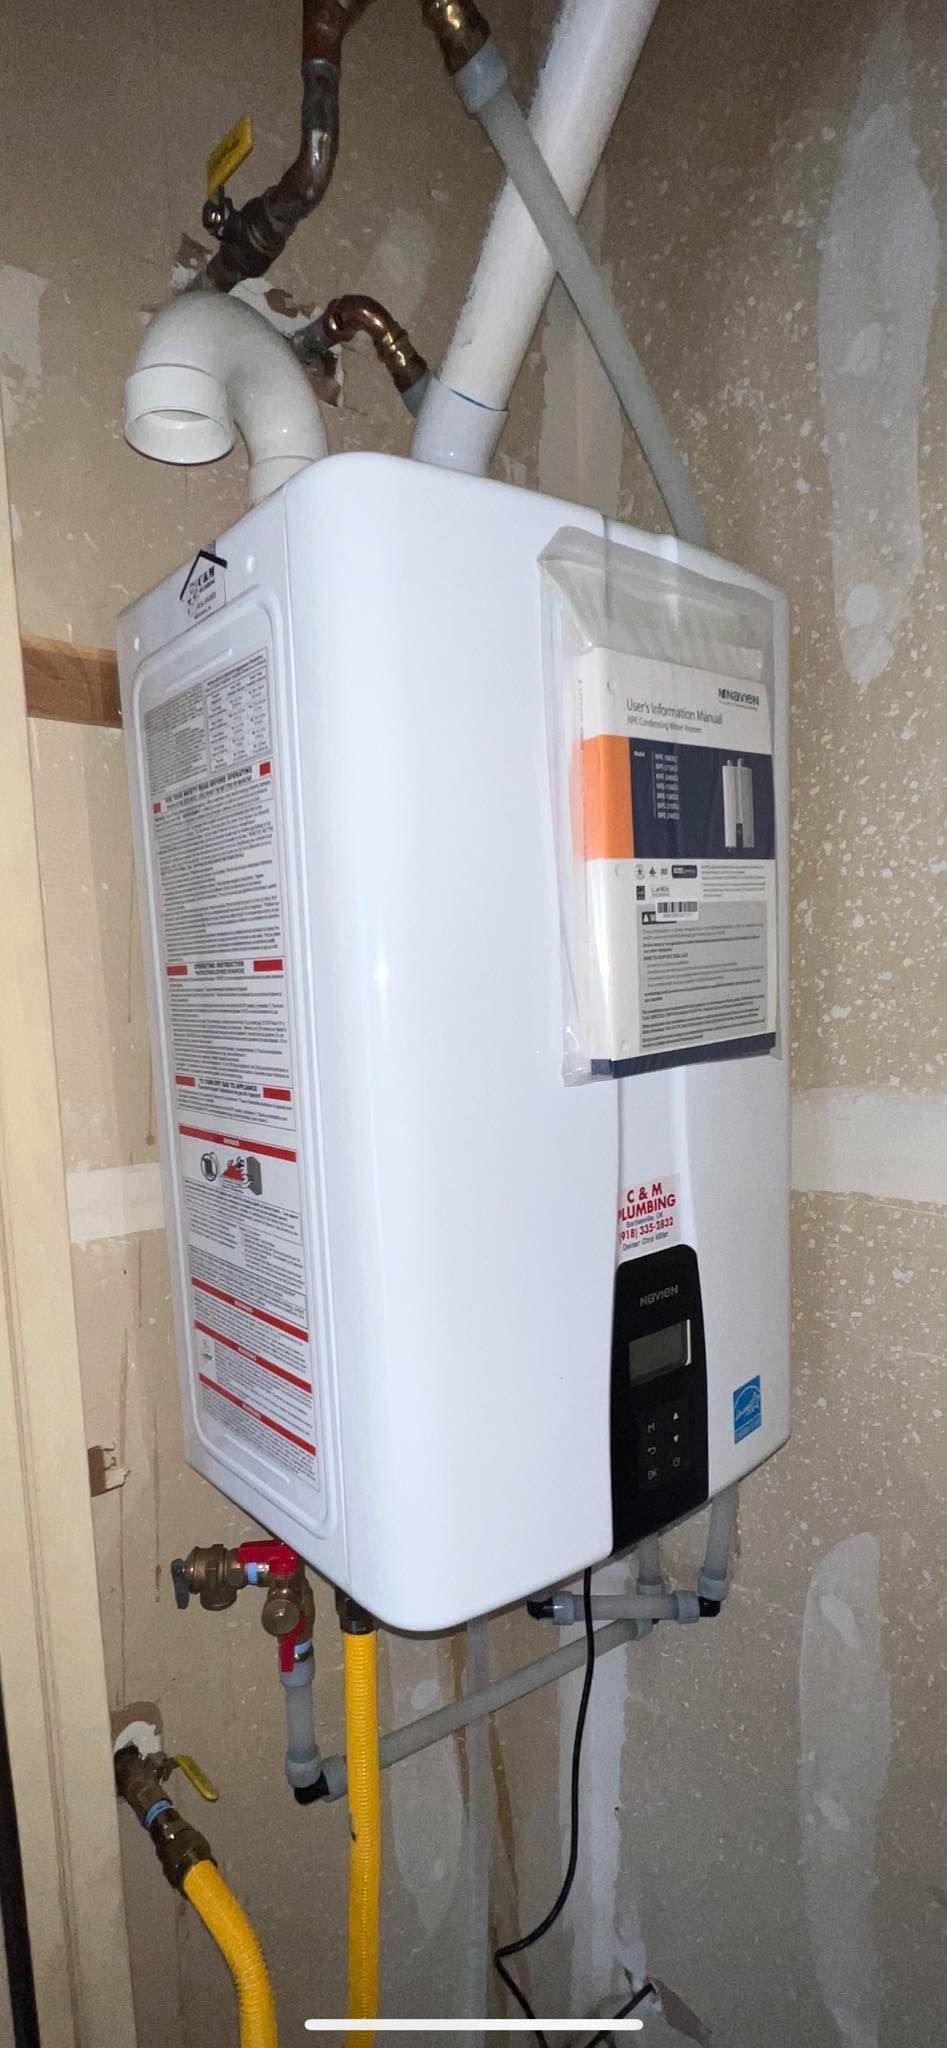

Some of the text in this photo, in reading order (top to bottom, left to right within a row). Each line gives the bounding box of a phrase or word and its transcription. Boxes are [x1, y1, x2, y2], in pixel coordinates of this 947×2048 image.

[627, 698, 722, 724] User's Information Manual
[627, 1182, 662, 1203] C & M
[640, 1216, 674, 1235] 335-2832
